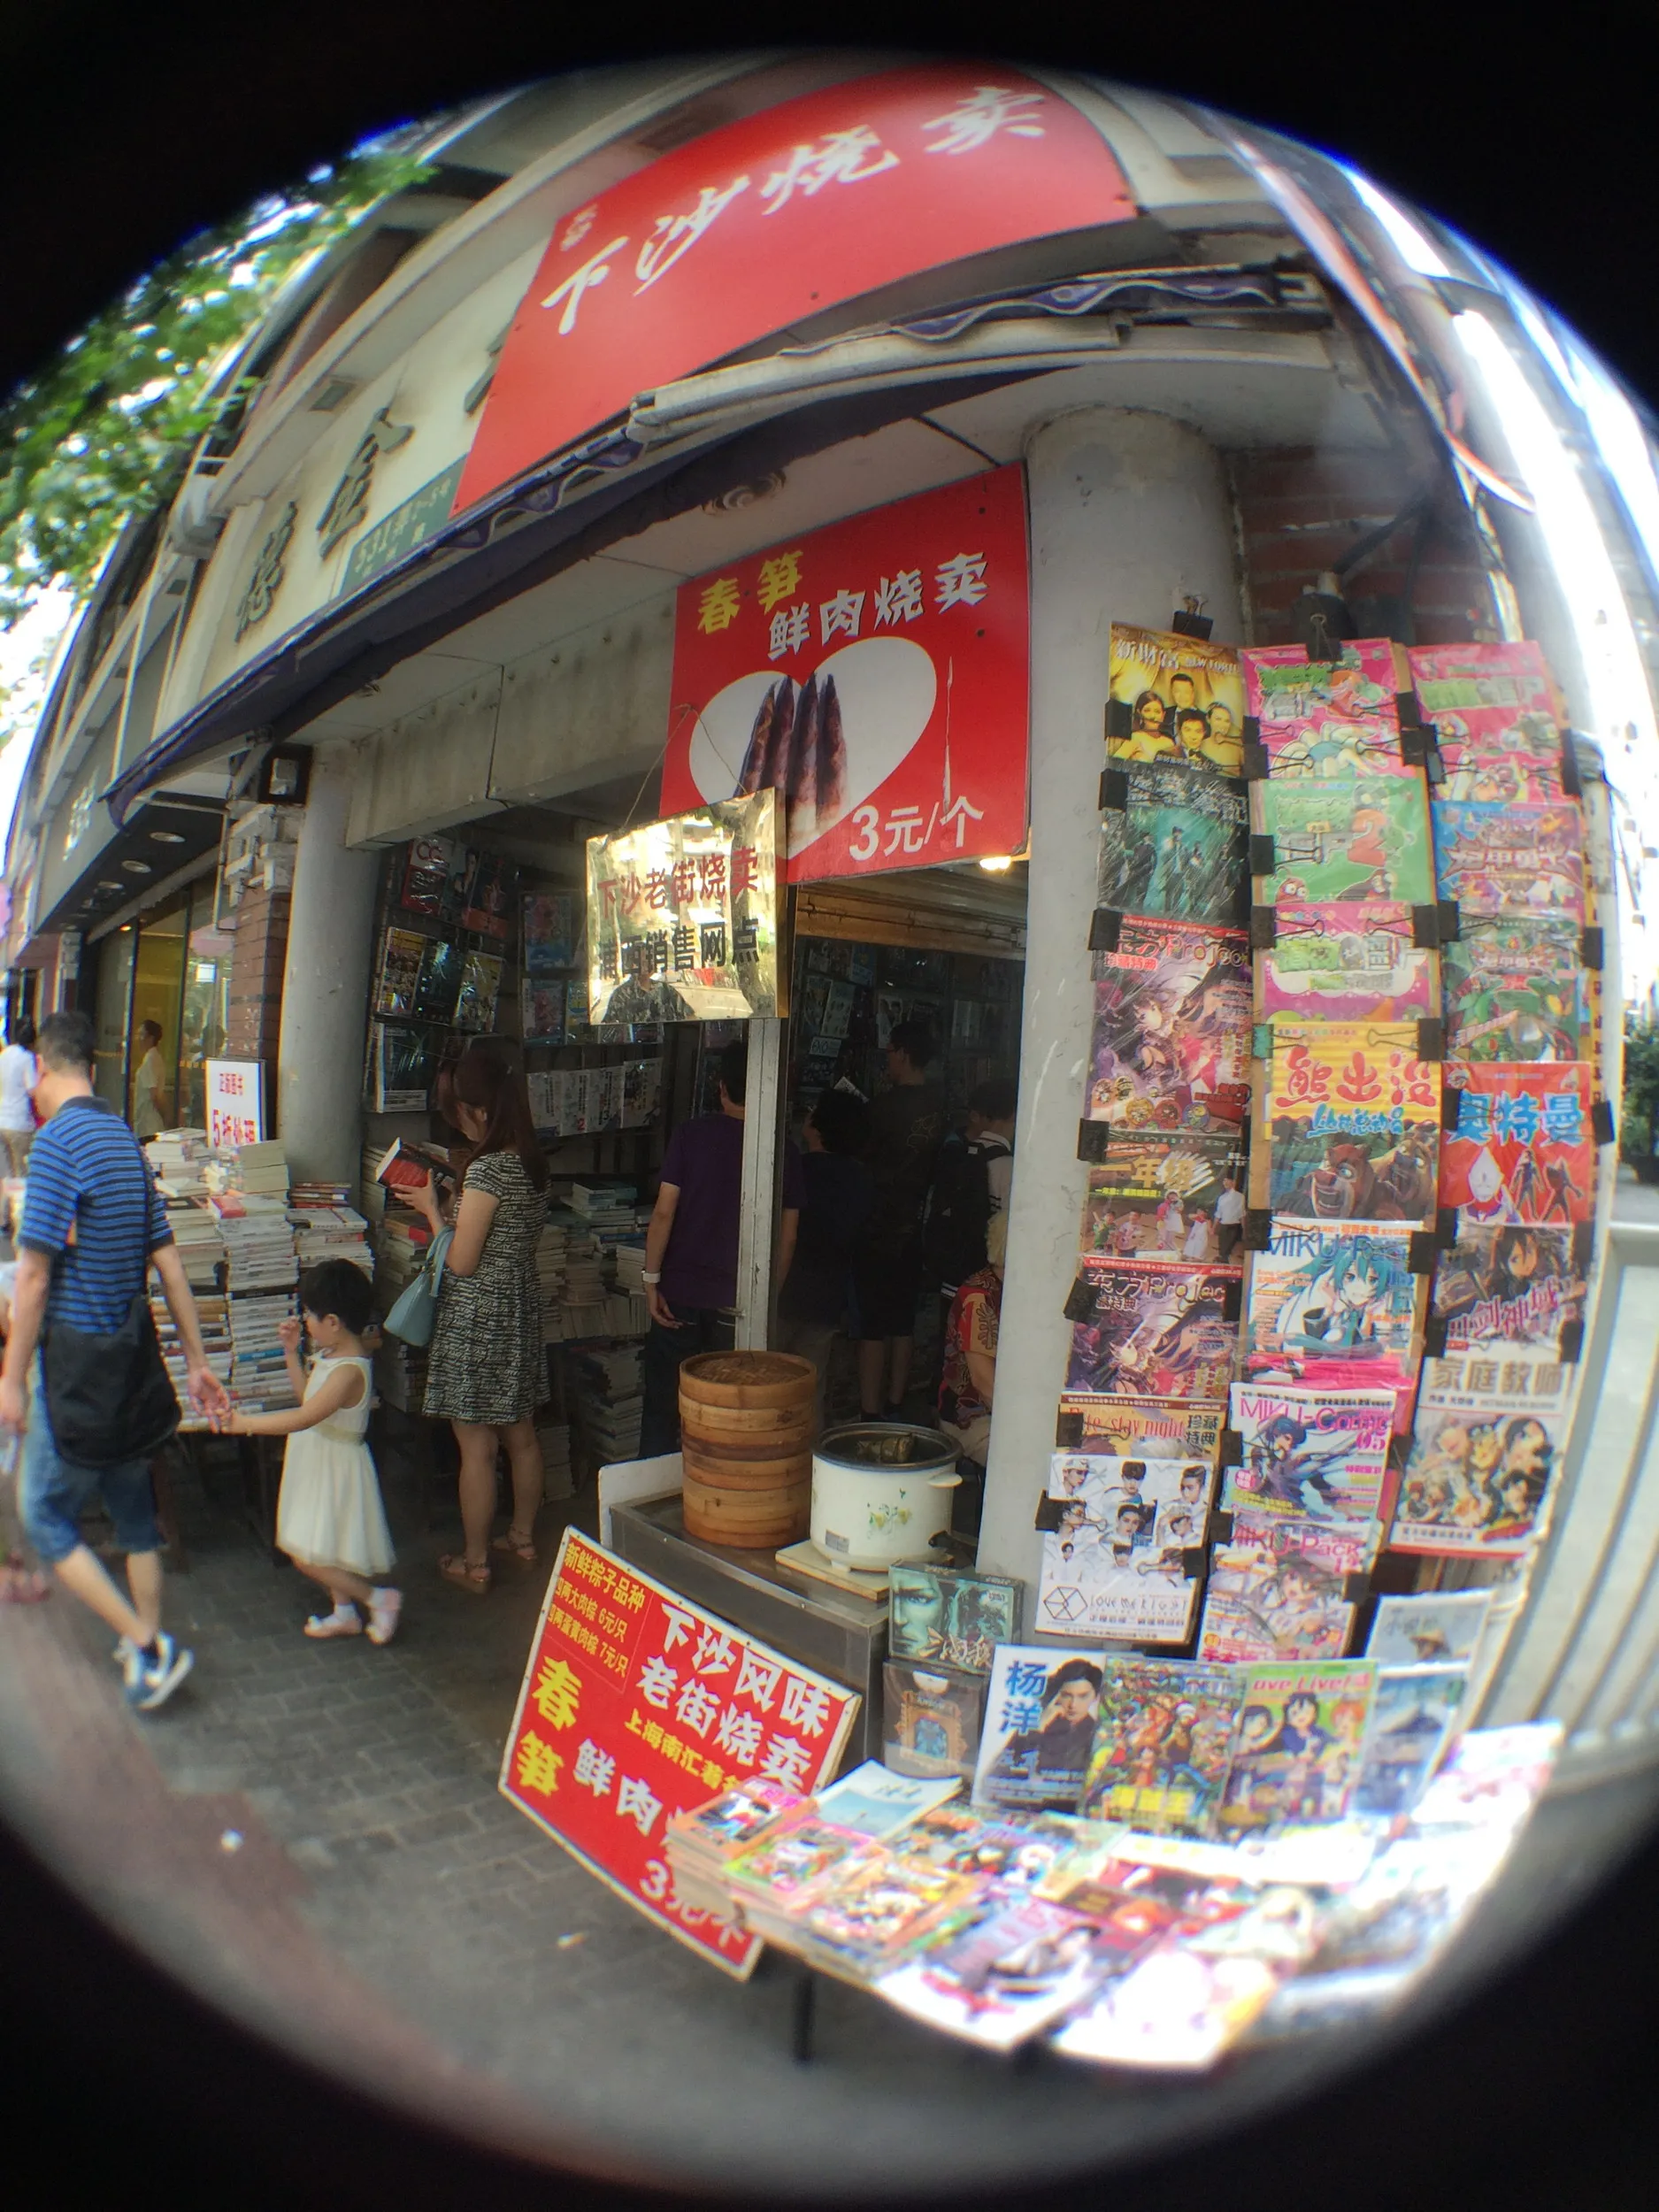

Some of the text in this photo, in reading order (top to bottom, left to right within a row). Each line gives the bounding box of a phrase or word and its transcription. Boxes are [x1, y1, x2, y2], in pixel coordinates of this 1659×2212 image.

[540, 85, 1049, 335] 下沙烧卖
[767, 552, 988, 661] 鲜肉烧卖
[848, 796, 985, 861] 3元/个
[595, 845, 759, 919] 下沙老街烧卖
[1275, 1045, 1437, 1108] 熊出没
[1446, 1090, 1586, 1148] 奥特曼
[1429, 1356, 1563, 1395] 家庭教师
[1356, 1432, 1386, 1451] 05
[564, 1542, 646, 1615] 新鲜粽子品种
[598, 1607, 629, 1644] 6元/只
[599, 1640, 630, 1678] 7元/只
[662, 1602, 830, 1739] 下沙风味
[999, 1660, 1048, 1736] 杨洋
[636, 1655, 812, 1791] 老街烧卖
